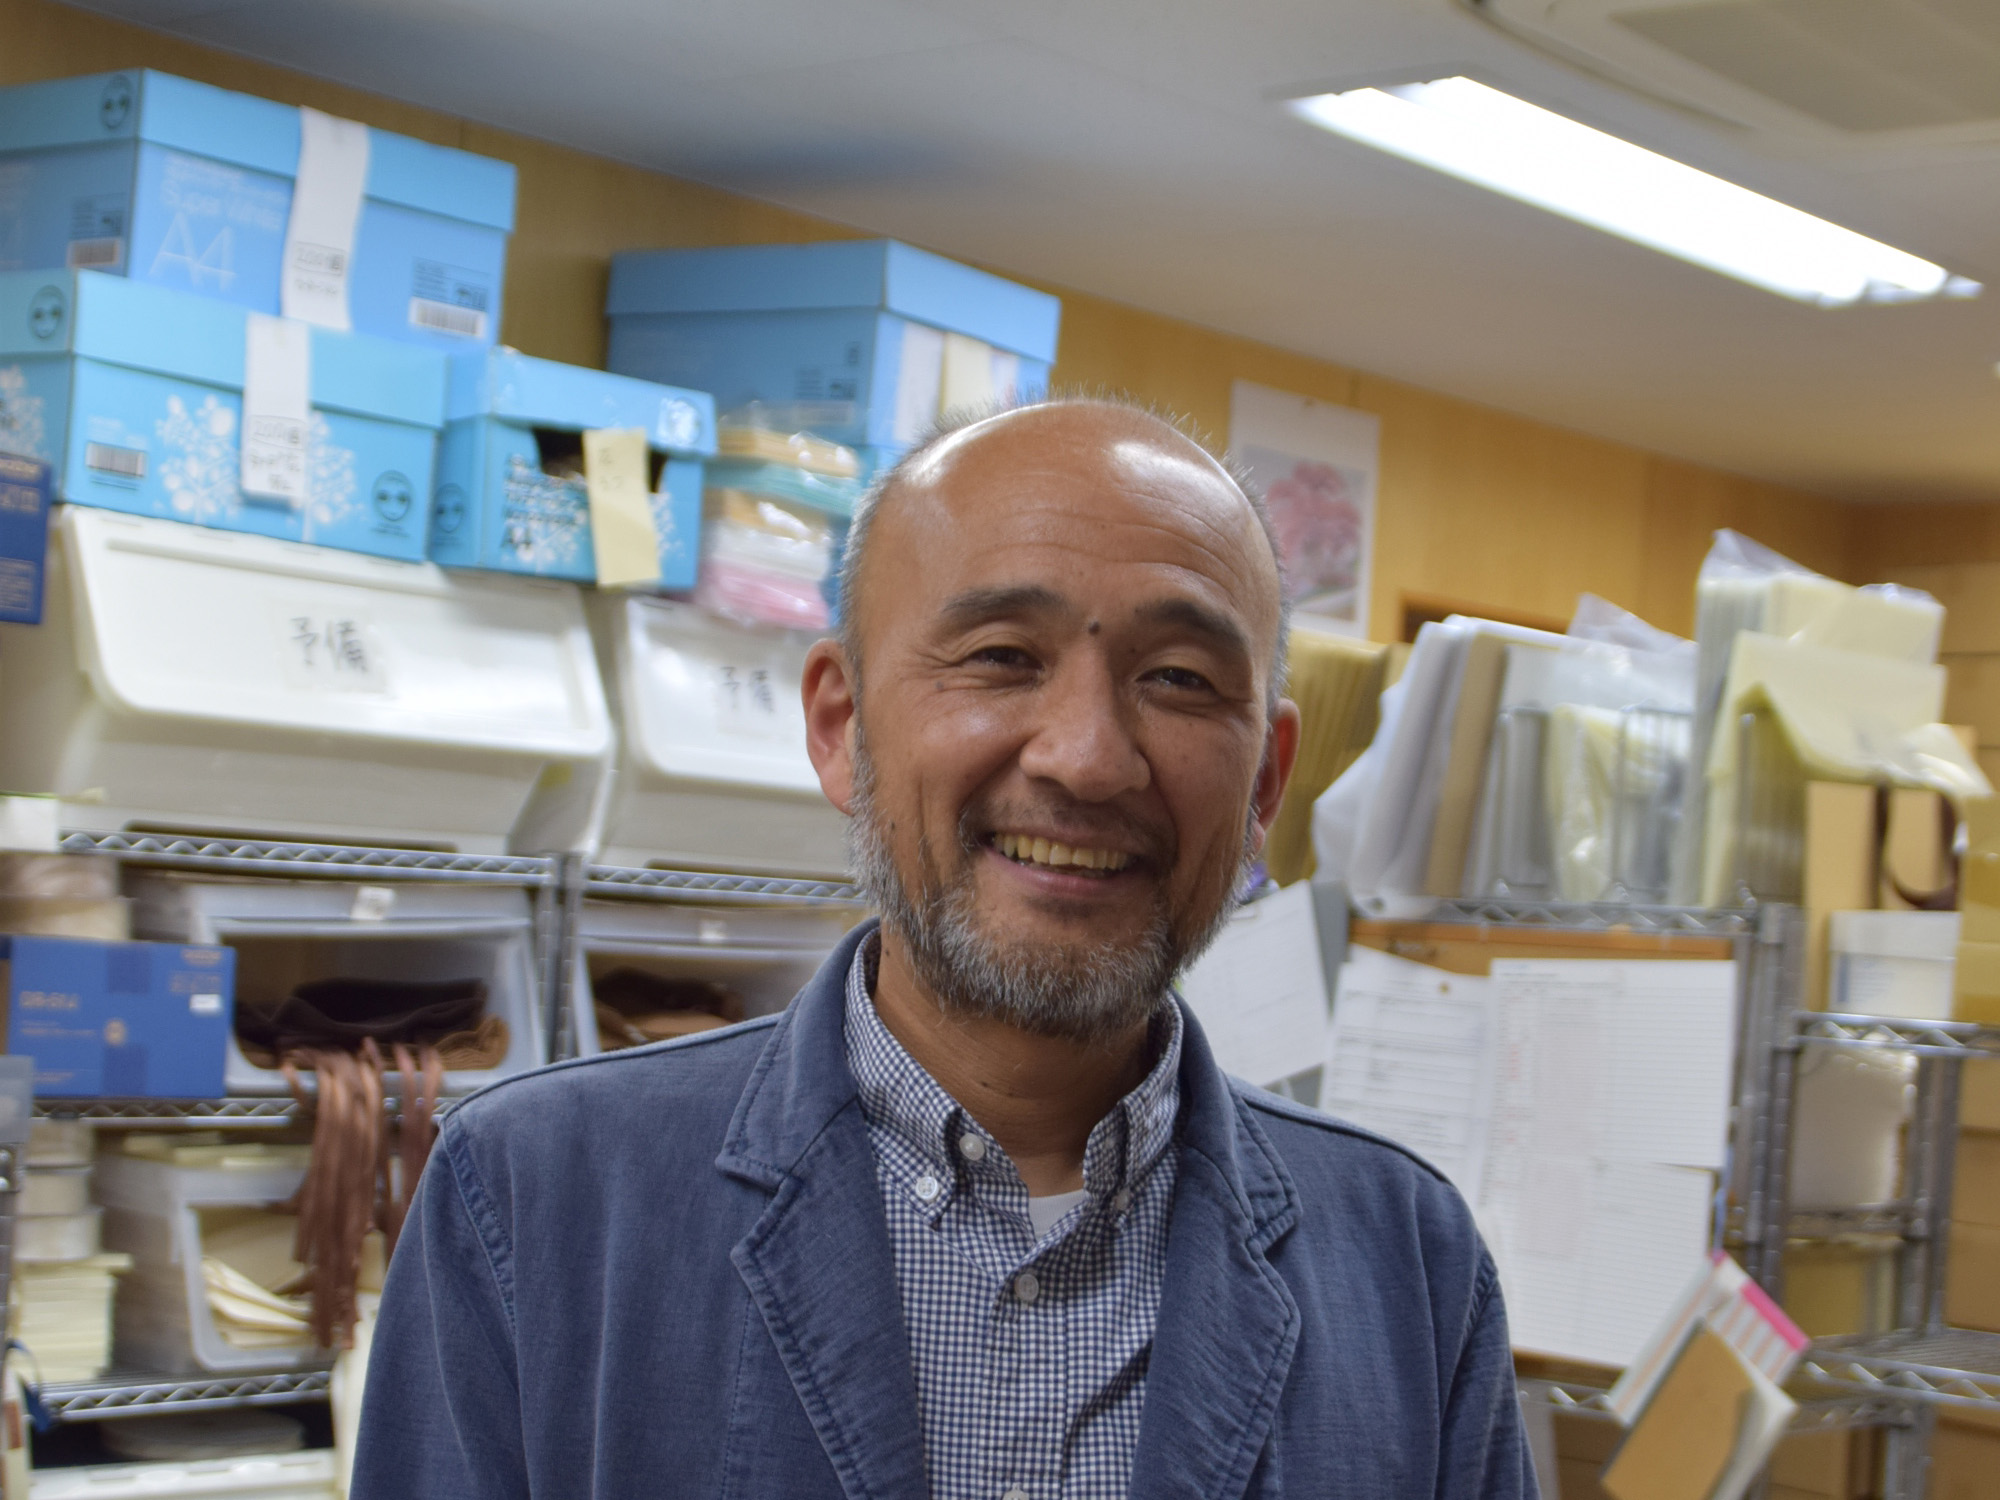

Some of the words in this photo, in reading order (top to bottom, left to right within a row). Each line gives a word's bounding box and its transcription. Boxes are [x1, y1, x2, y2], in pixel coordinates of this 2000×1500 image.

[149, 212, 238, 292] A4
[289, 616, 368, 674] 予備
[721, 666, 775, 713] 予備
